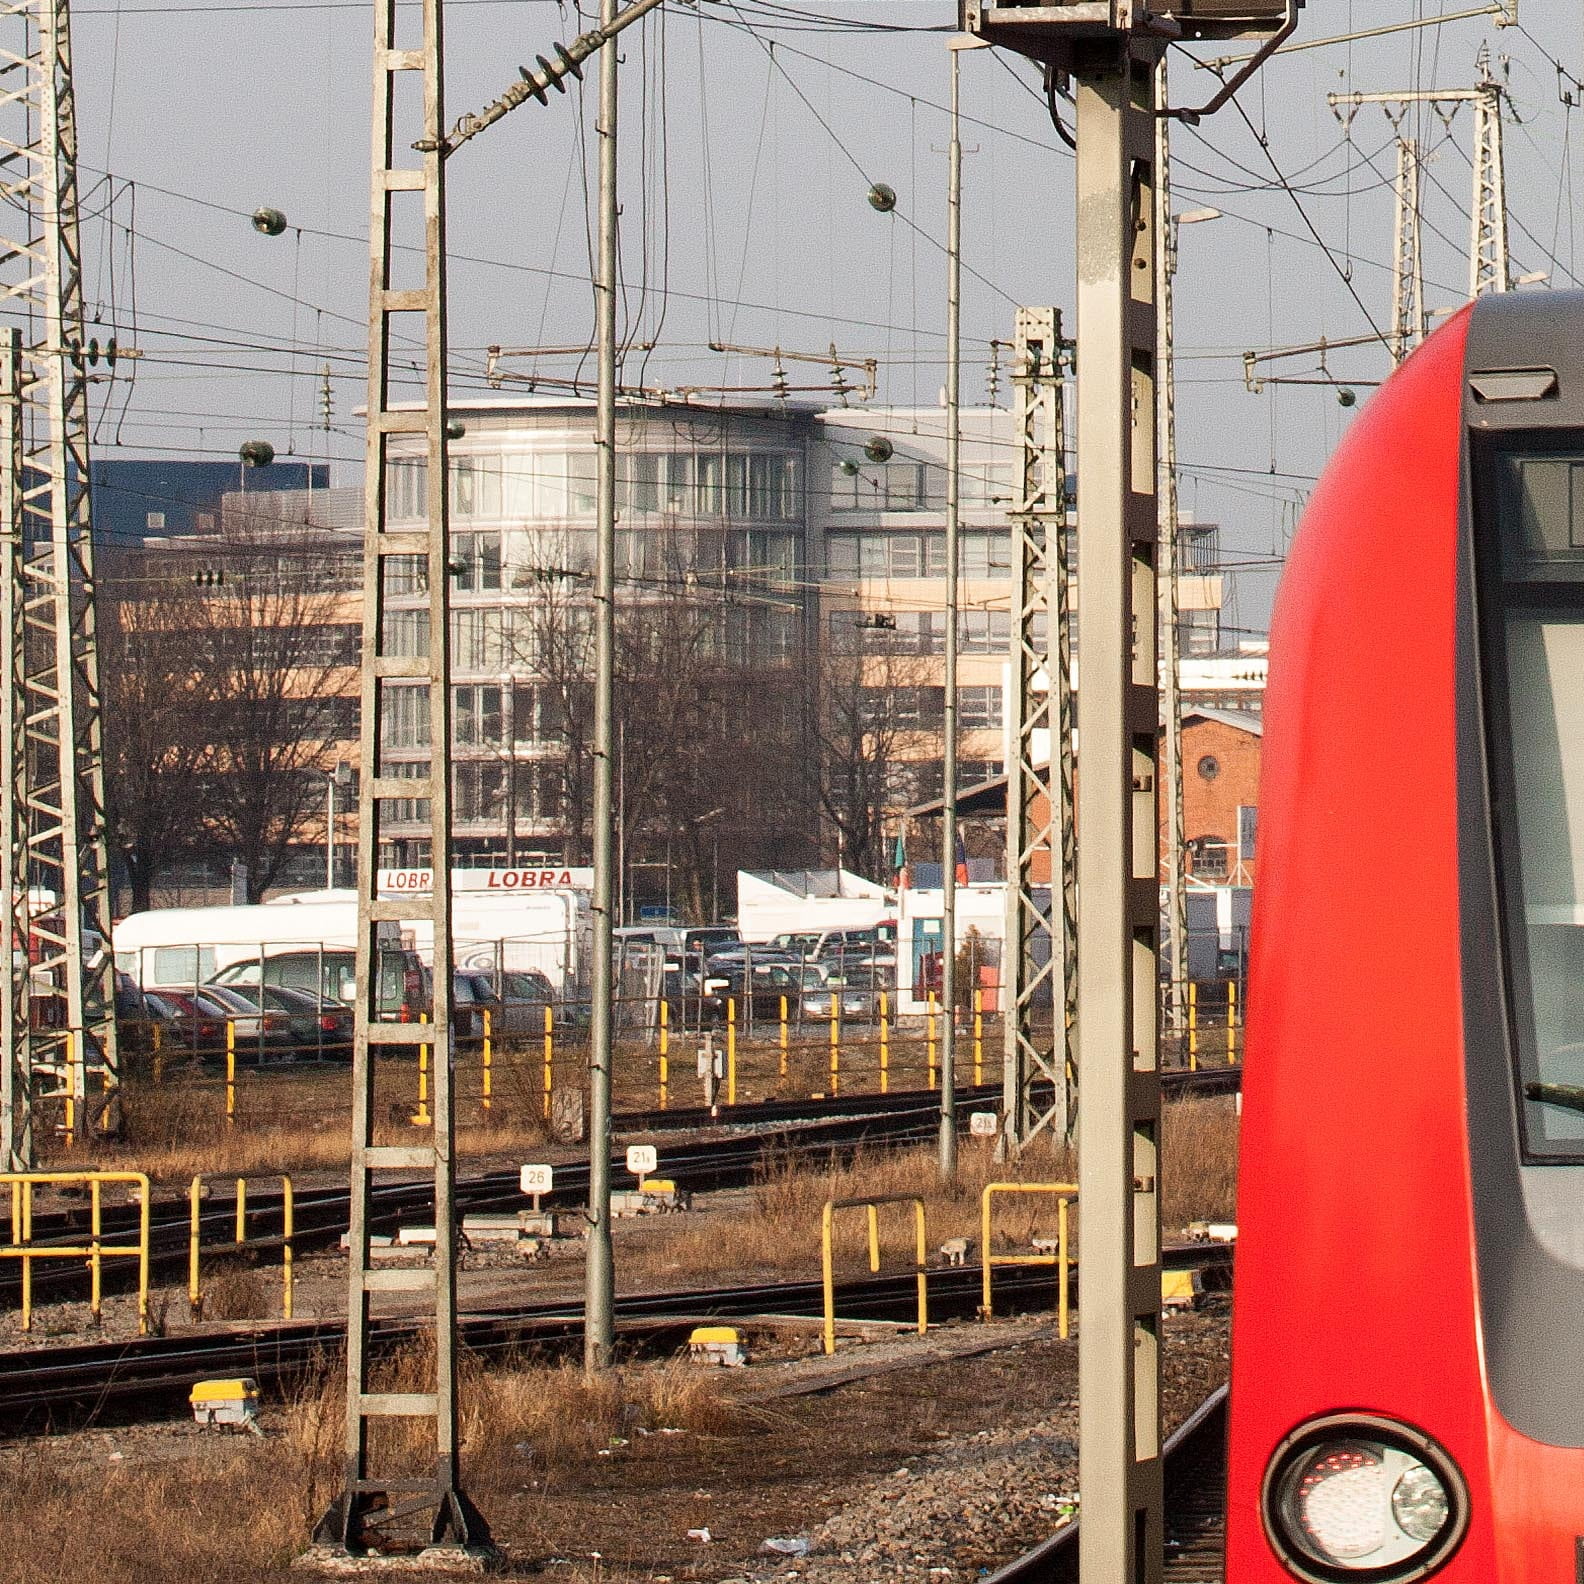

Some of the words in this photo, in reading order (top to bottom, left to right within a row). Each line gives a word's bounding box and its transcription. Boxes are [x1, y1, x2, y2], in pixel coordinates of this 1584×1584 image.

[386, 871, 431, 889] LOBR
[487, 870, 572, 888] LOBRA
[528, 1170, 545, 1184] 26
